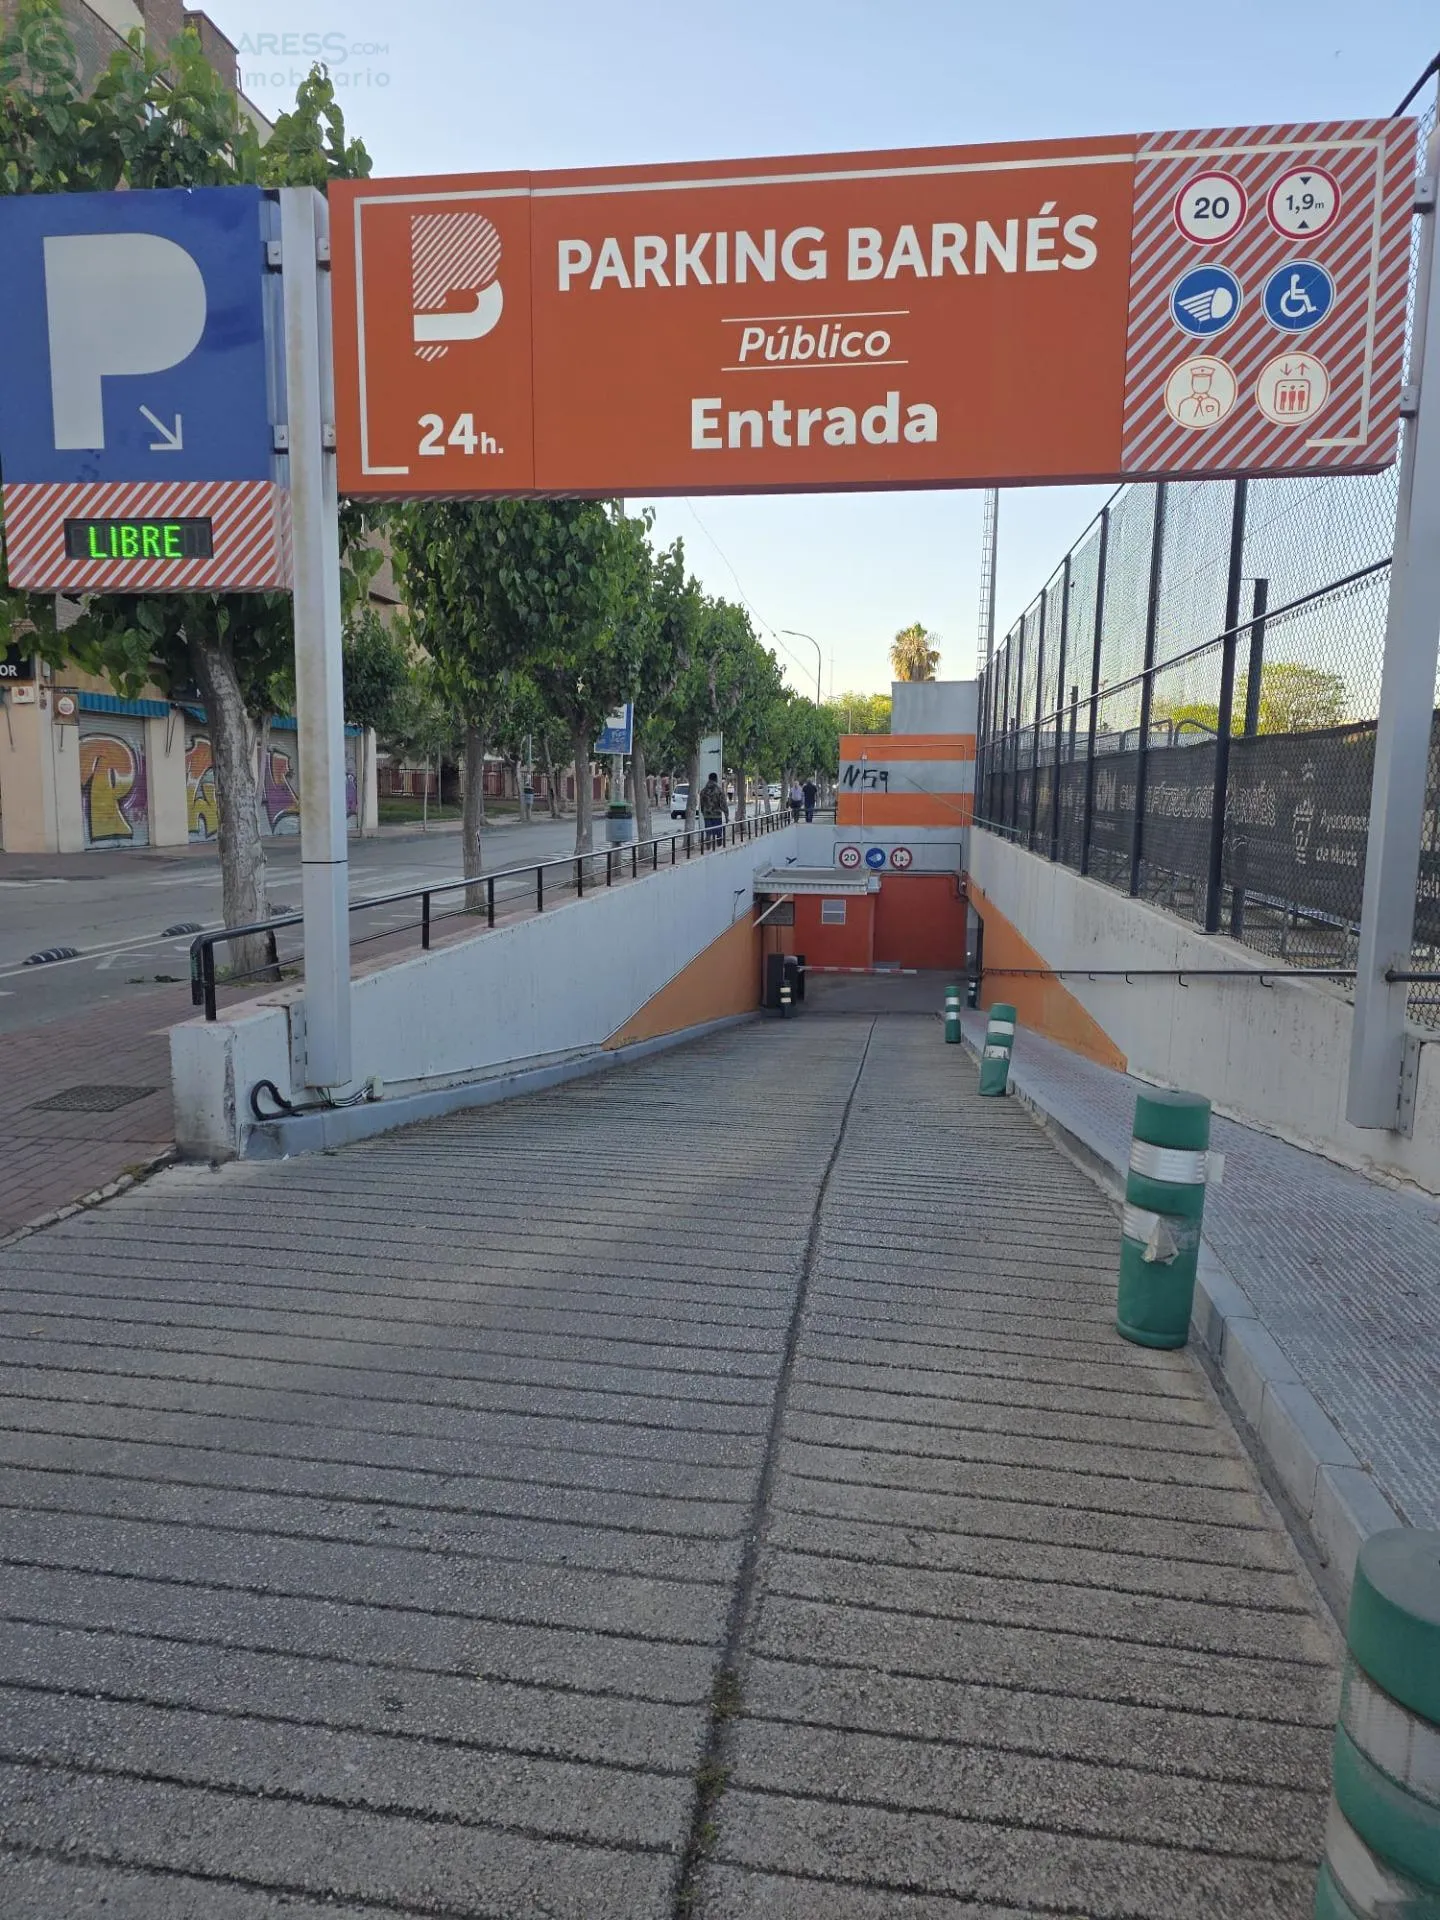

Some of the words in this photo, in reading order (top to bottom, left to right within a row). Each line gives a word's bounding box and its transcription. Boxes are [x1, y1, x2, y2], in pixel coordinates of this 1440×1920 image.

[1194, 196, 1230, 220] 20
[558, 226, 828, 292] PARKING
[847, 200, 1099, 281] BARNÉS
[43, 232, 207, 450] P
[738, 323, 892, 362] Público
[417, 413, 505, 456] 24h.
[691, 391, 938, 450] Entrada
[88, 524, 183, 558] LIBRE
[844, 853, 857, 862] 20
